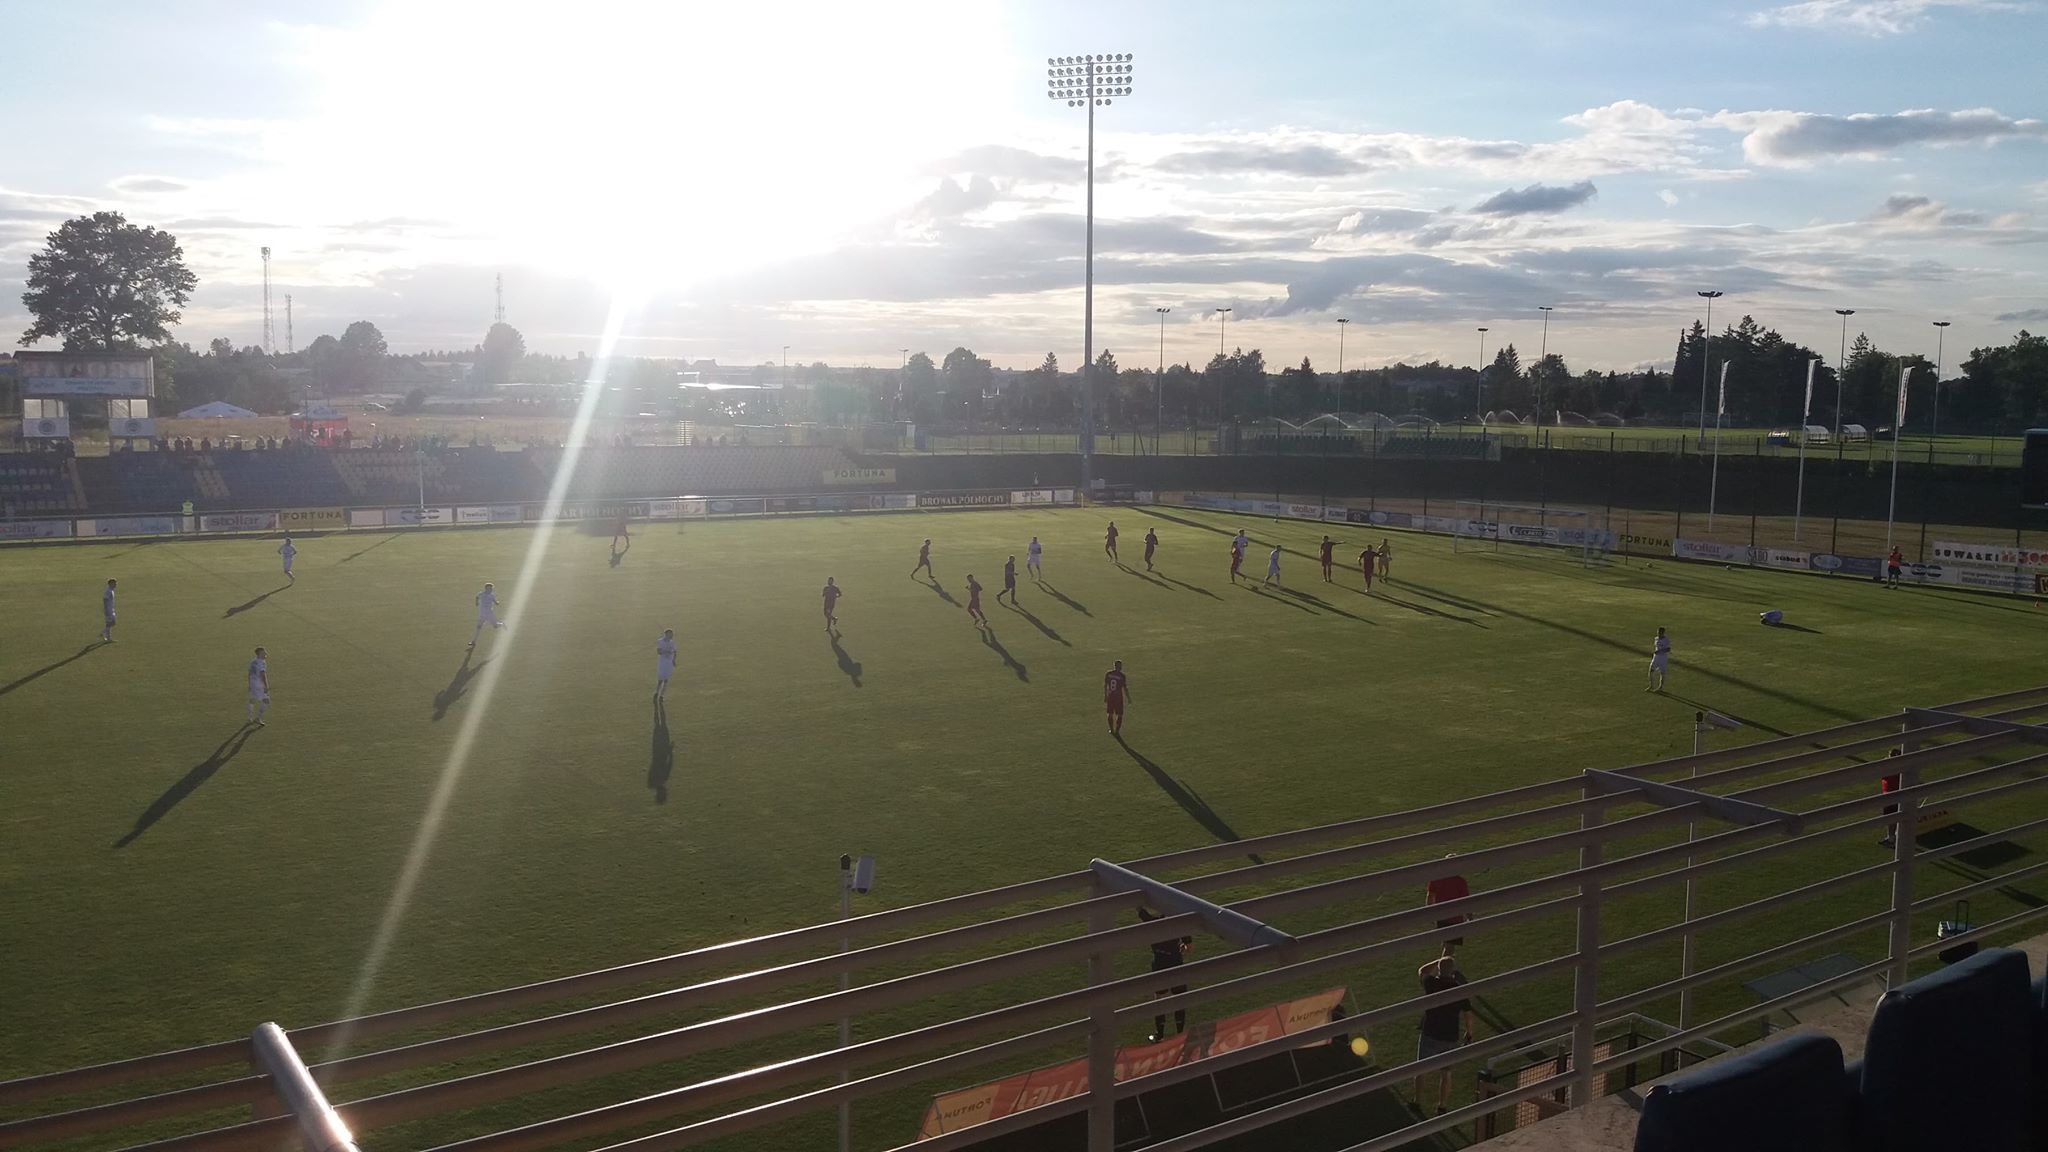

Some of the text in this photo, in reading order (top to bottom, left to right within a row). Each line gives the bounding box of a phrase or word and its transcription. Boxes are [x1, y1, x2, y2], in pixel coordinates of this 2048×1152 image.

[833, 469, 886, 479] FORTUNA
[209, 513, 261, 527] stollar
[282, 508, 343, 521] FORTUNA
[1618, 533, 1670, 548] FORTUNA
[1683, 542, 1721, 554] stollar
